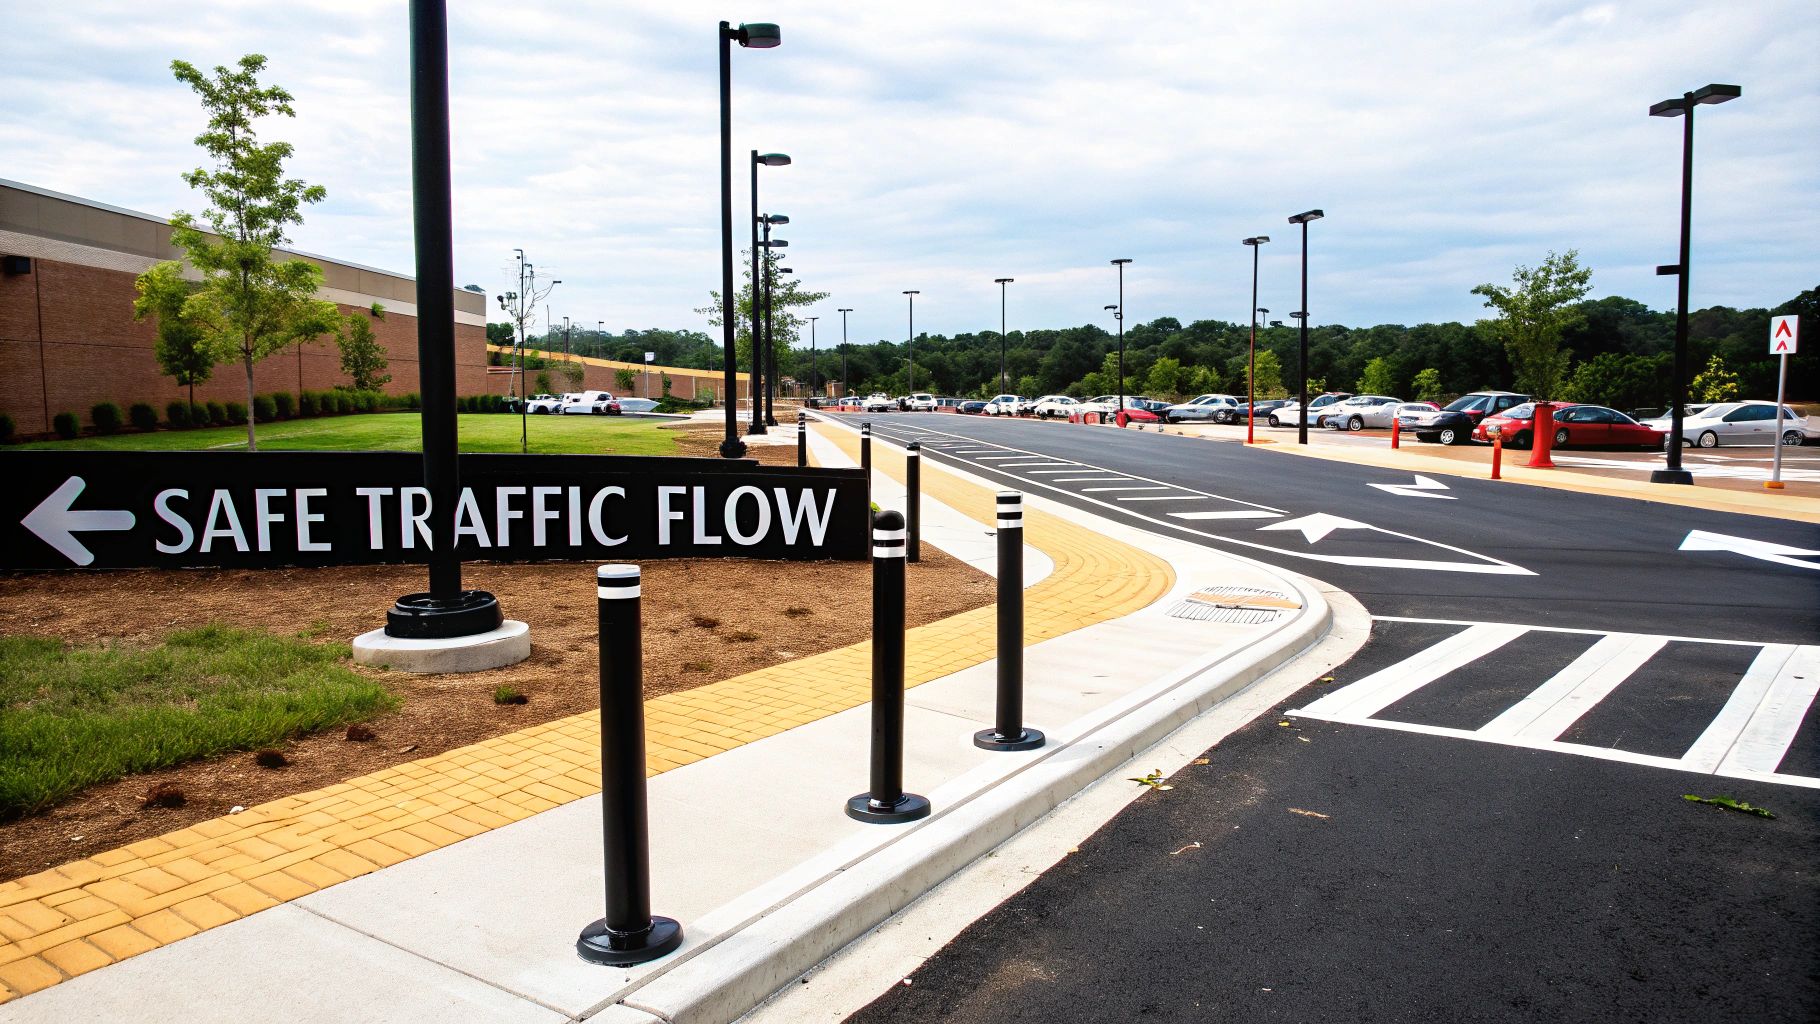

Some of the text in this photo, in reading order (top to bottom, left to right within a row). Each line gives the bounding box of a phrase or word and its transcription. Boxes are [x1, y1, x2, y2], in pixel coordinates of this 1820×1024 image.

[154, 485, 837, 554] SAFE TRAFFIC FLOW
